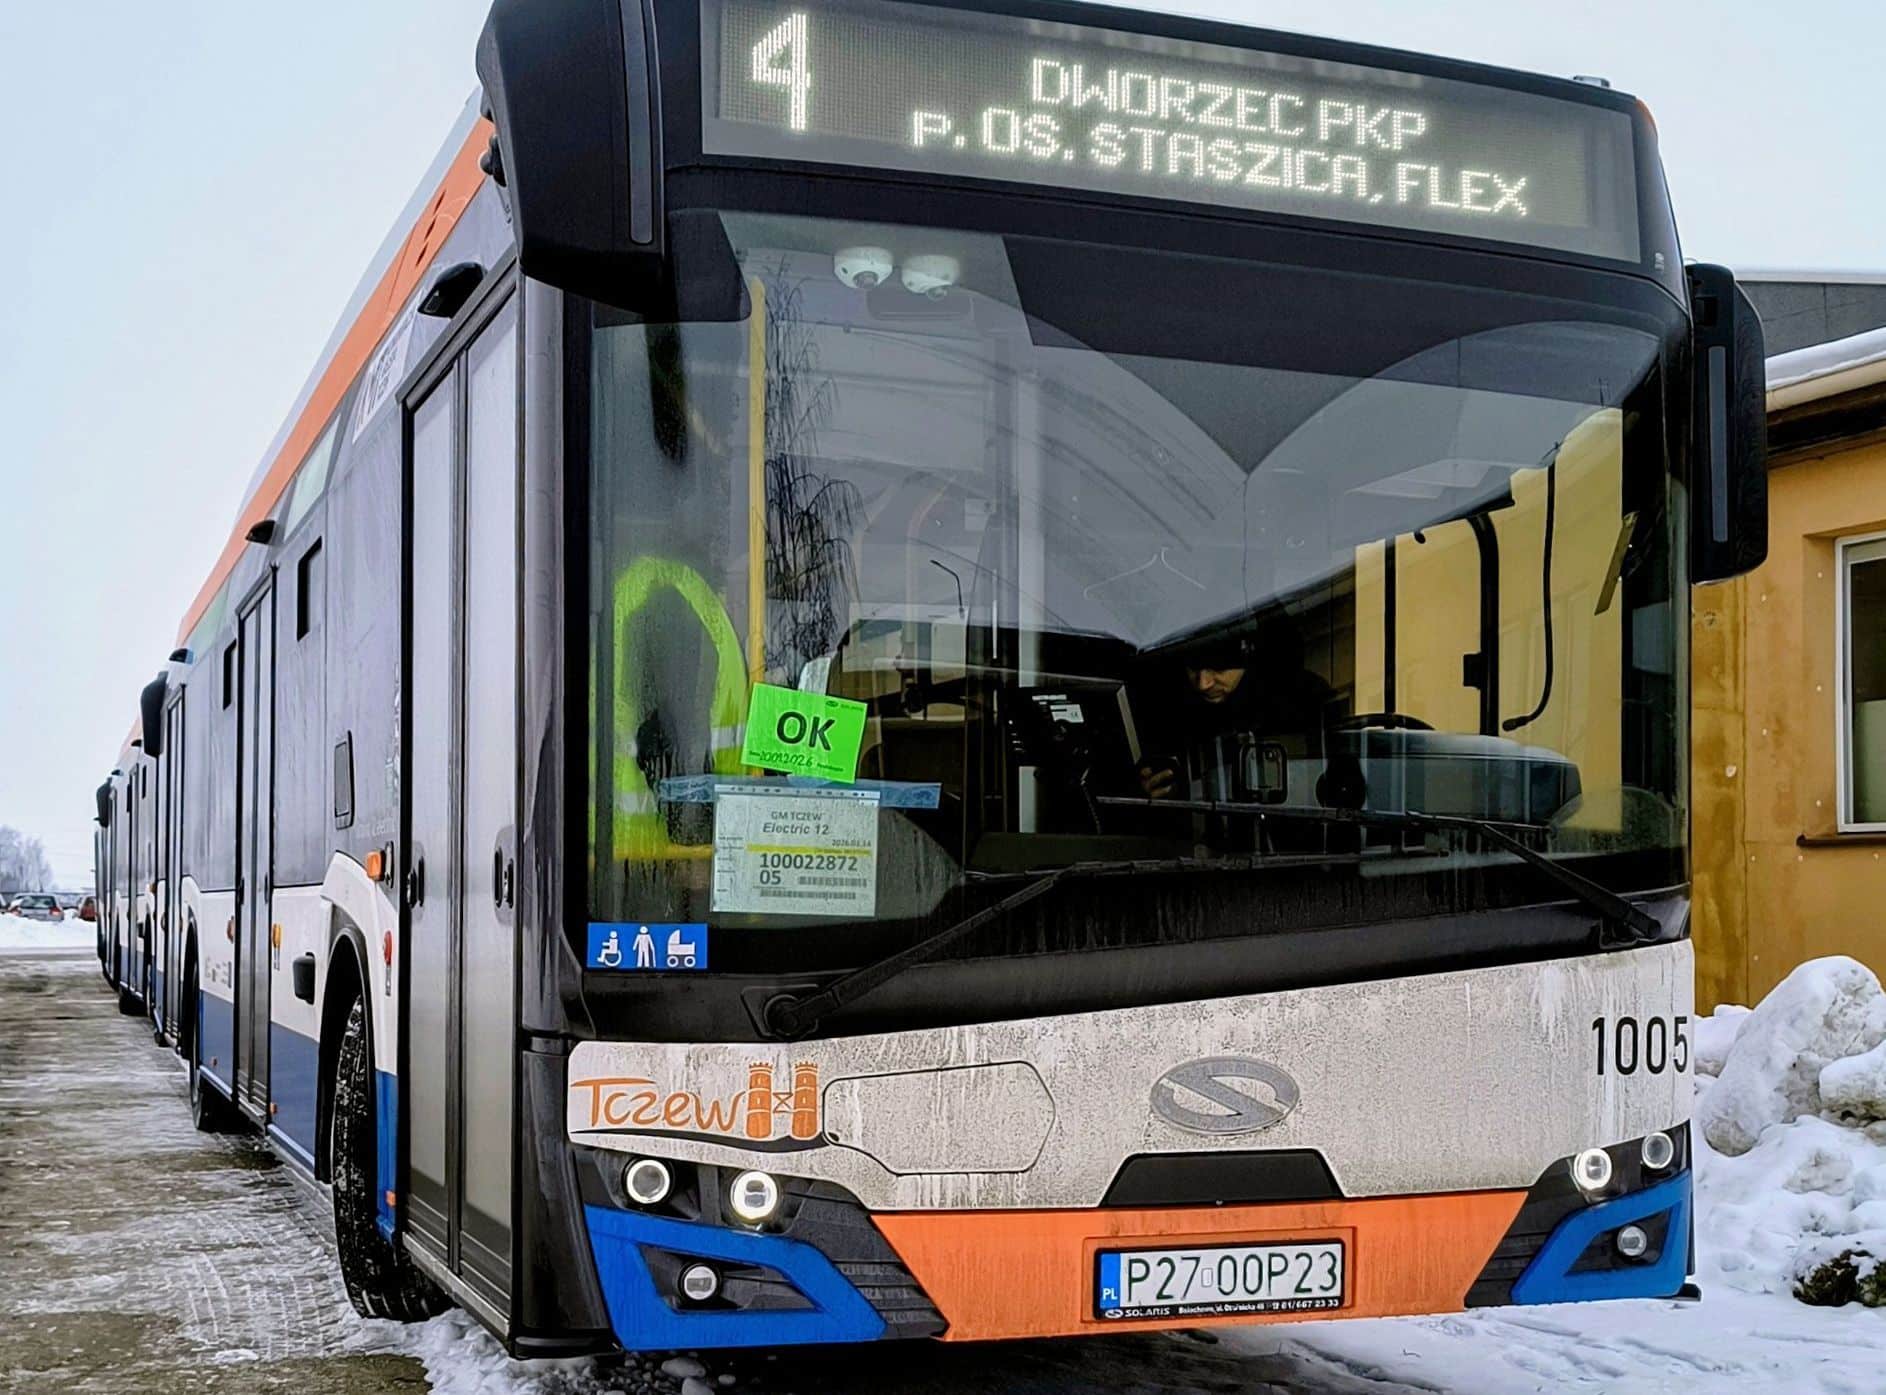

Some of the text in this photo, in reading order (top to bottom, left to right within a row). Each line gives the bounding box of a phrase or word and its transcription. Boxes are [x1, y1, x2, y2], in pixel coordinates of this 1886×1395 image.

[751, 11, 812, 131] 4
[1032, 57, 1427, 151] DWORZEC PKP
[982, 107, 1074, 161] OS.
[1090, 123, 1384, 204] STASZICA,
[1396, 162, 1528, 217] FLEX
[776, 711, 836, 752] OK
[762, 822, 830, 836] Electric 12
[759, 852, 858, 872] 100022872
[759, 869, 782, 886] 05
[1591, 1015, 1688, 1076] 1005
[570, 1077, 746, 1132] Tczew
[1102, 1288, 1118, 1301] PL
